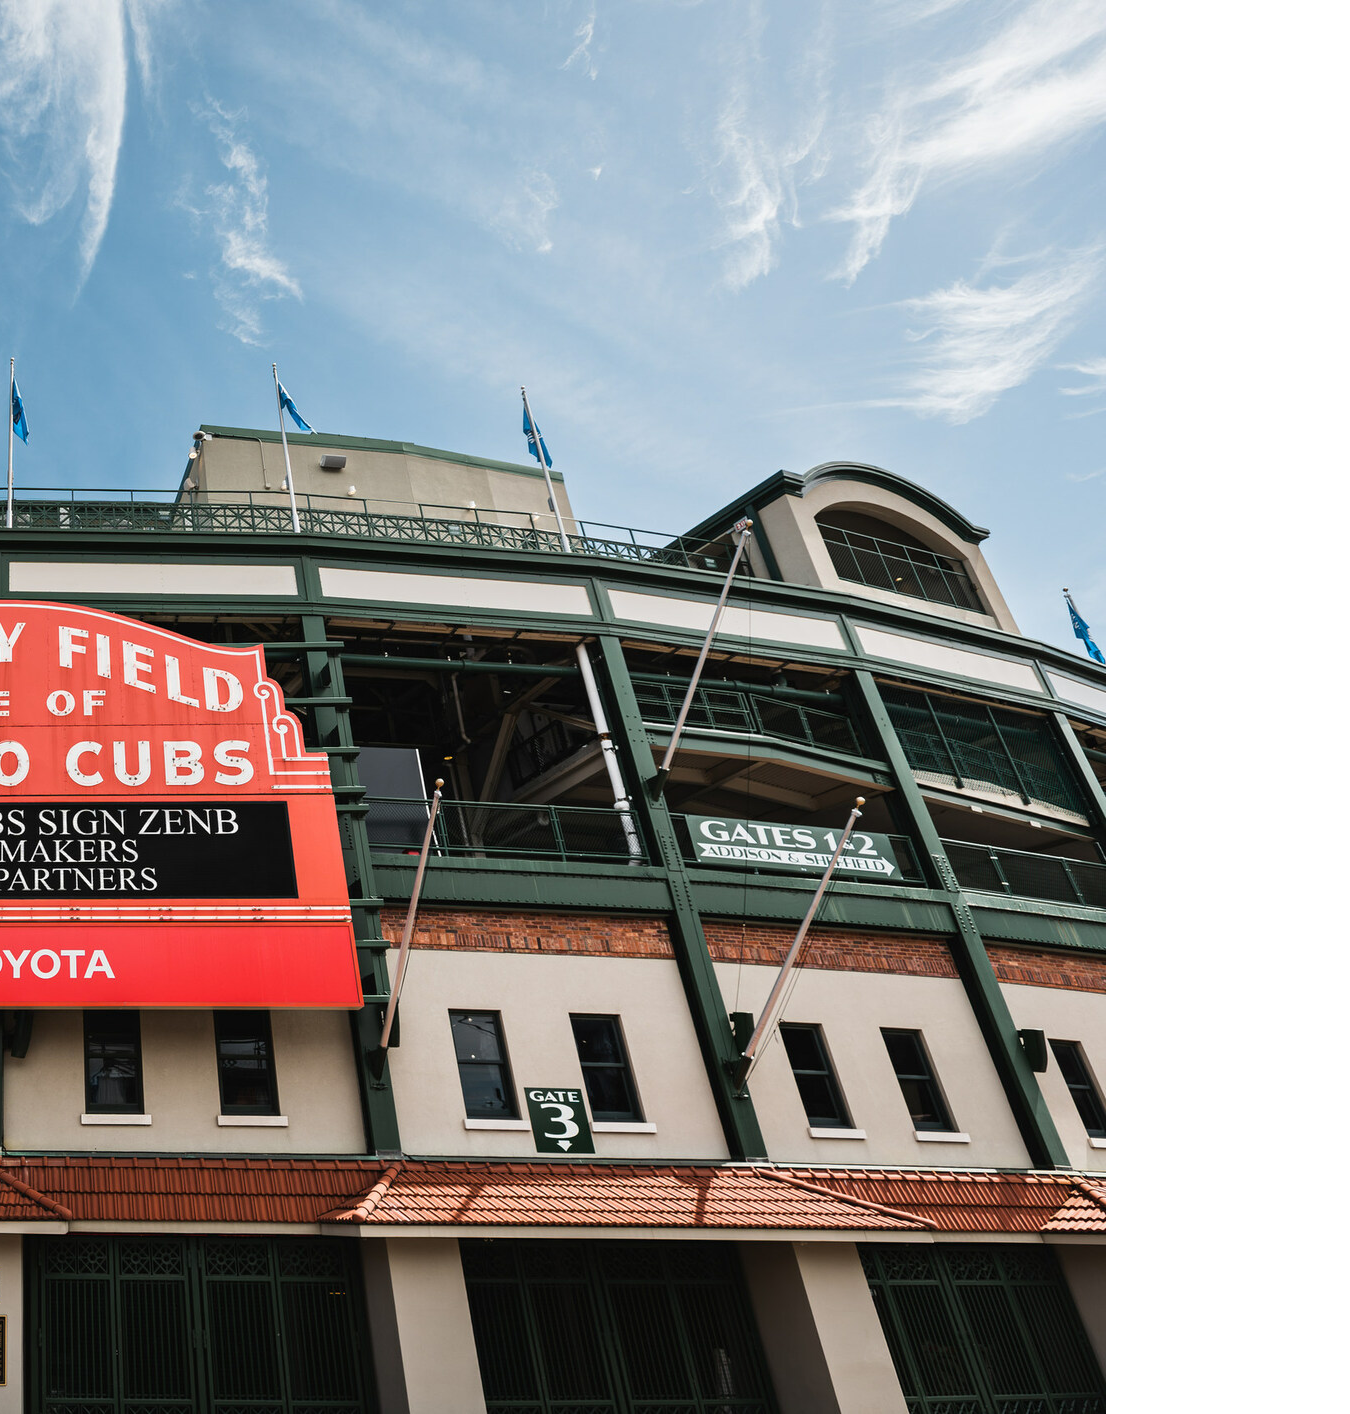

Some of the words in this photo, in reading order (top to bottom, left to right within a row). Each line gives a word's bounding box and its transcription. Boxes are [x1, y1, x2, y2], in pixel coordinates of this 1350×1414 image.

[58, 626, 244, 713] FIELD
[46, 689, 107, 717] OF
[65, 739, 256, 787] CUBS
[38, 809, 126, 836] SIGN
[137, 808, 239, 836] ZENB
[699, 820, 817, 849] GATES
[704, 846, 782, 861] ADDISON
[787, 852, 799, 863] &
[529, 1090, 580, 1103] GATE
[539, 1102, 580, 1139] 3
